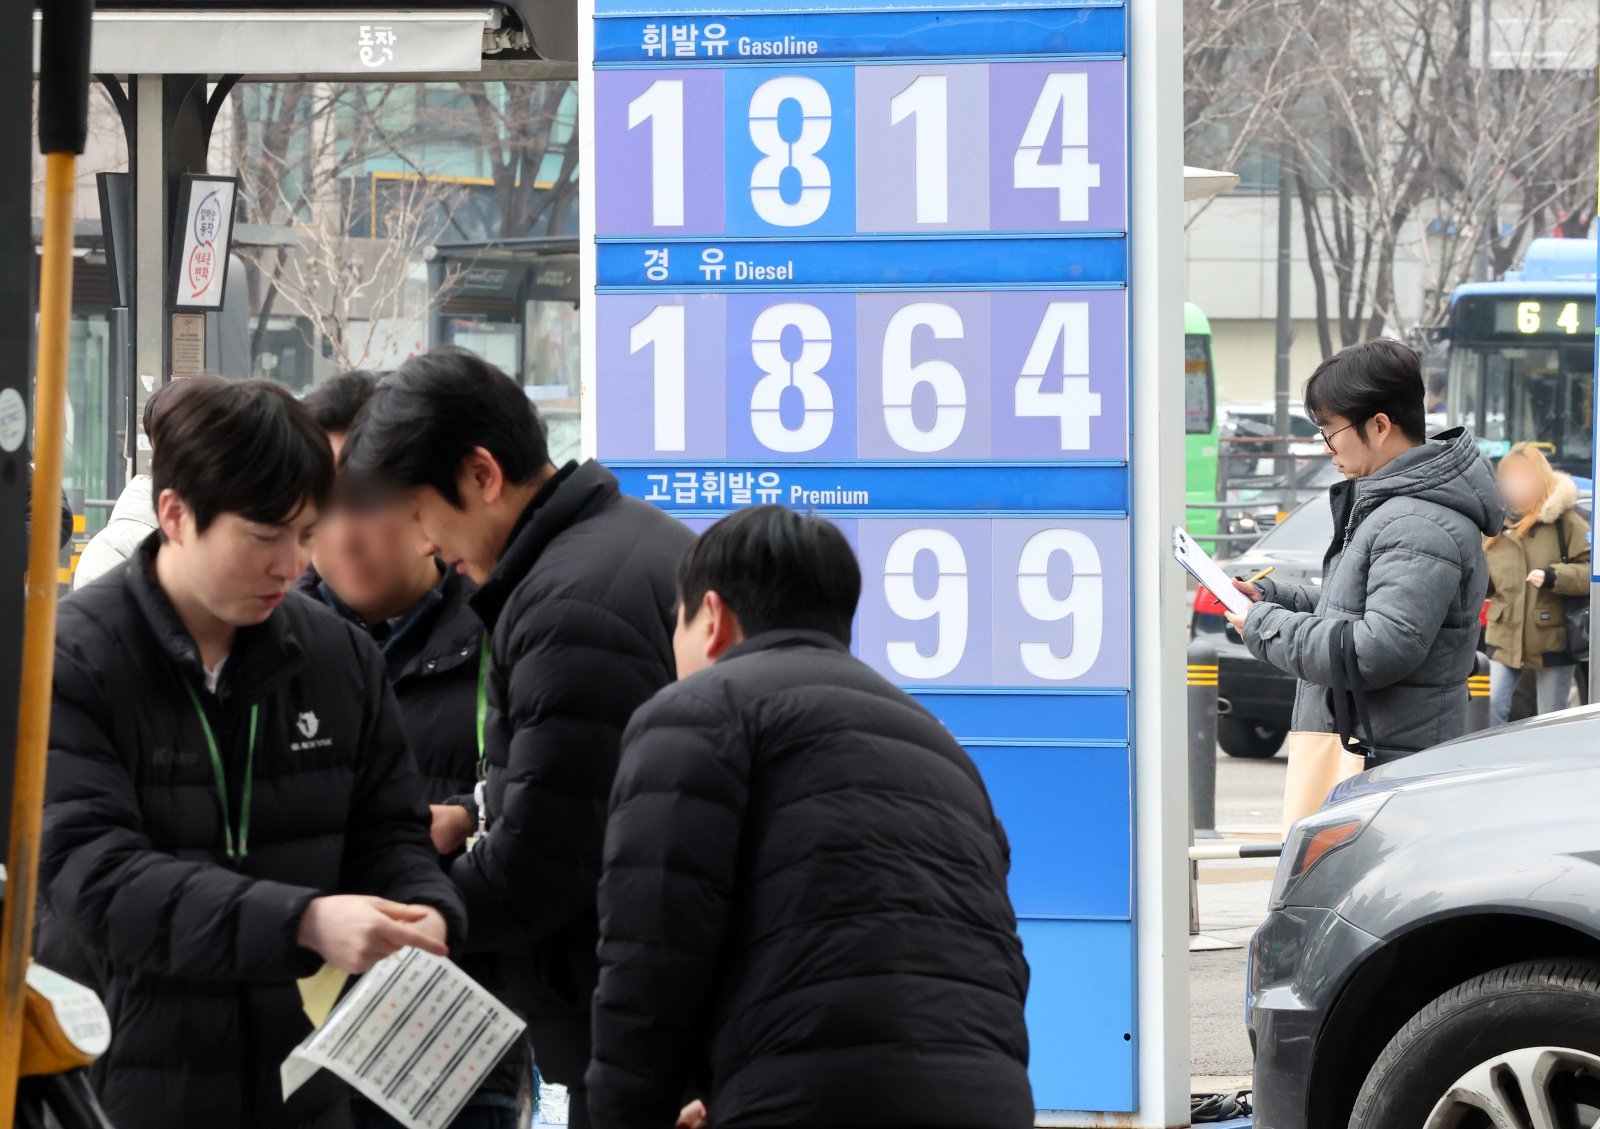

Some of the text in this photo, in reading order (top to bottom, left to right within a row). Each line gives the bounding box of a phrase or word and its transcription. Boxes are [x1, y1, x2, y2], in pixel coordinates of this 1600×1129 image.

[358, 25, 397, 67] 동작
[641, 23, 818, 57] 휘발유 Gasoline
[628, 72, 1100, 227] 1814
[199, 222, 214, 237] 동작
[194, 252, 211, 266] 새로운
[194, 267, 209, 281] 변화
[735, 260, 793, 280] Diesel
[629, 302, 1101, 453] 1864
[644, 471, 869, 505] 고급휘발유 Premium
[883, 527, 1104, 680] 99
